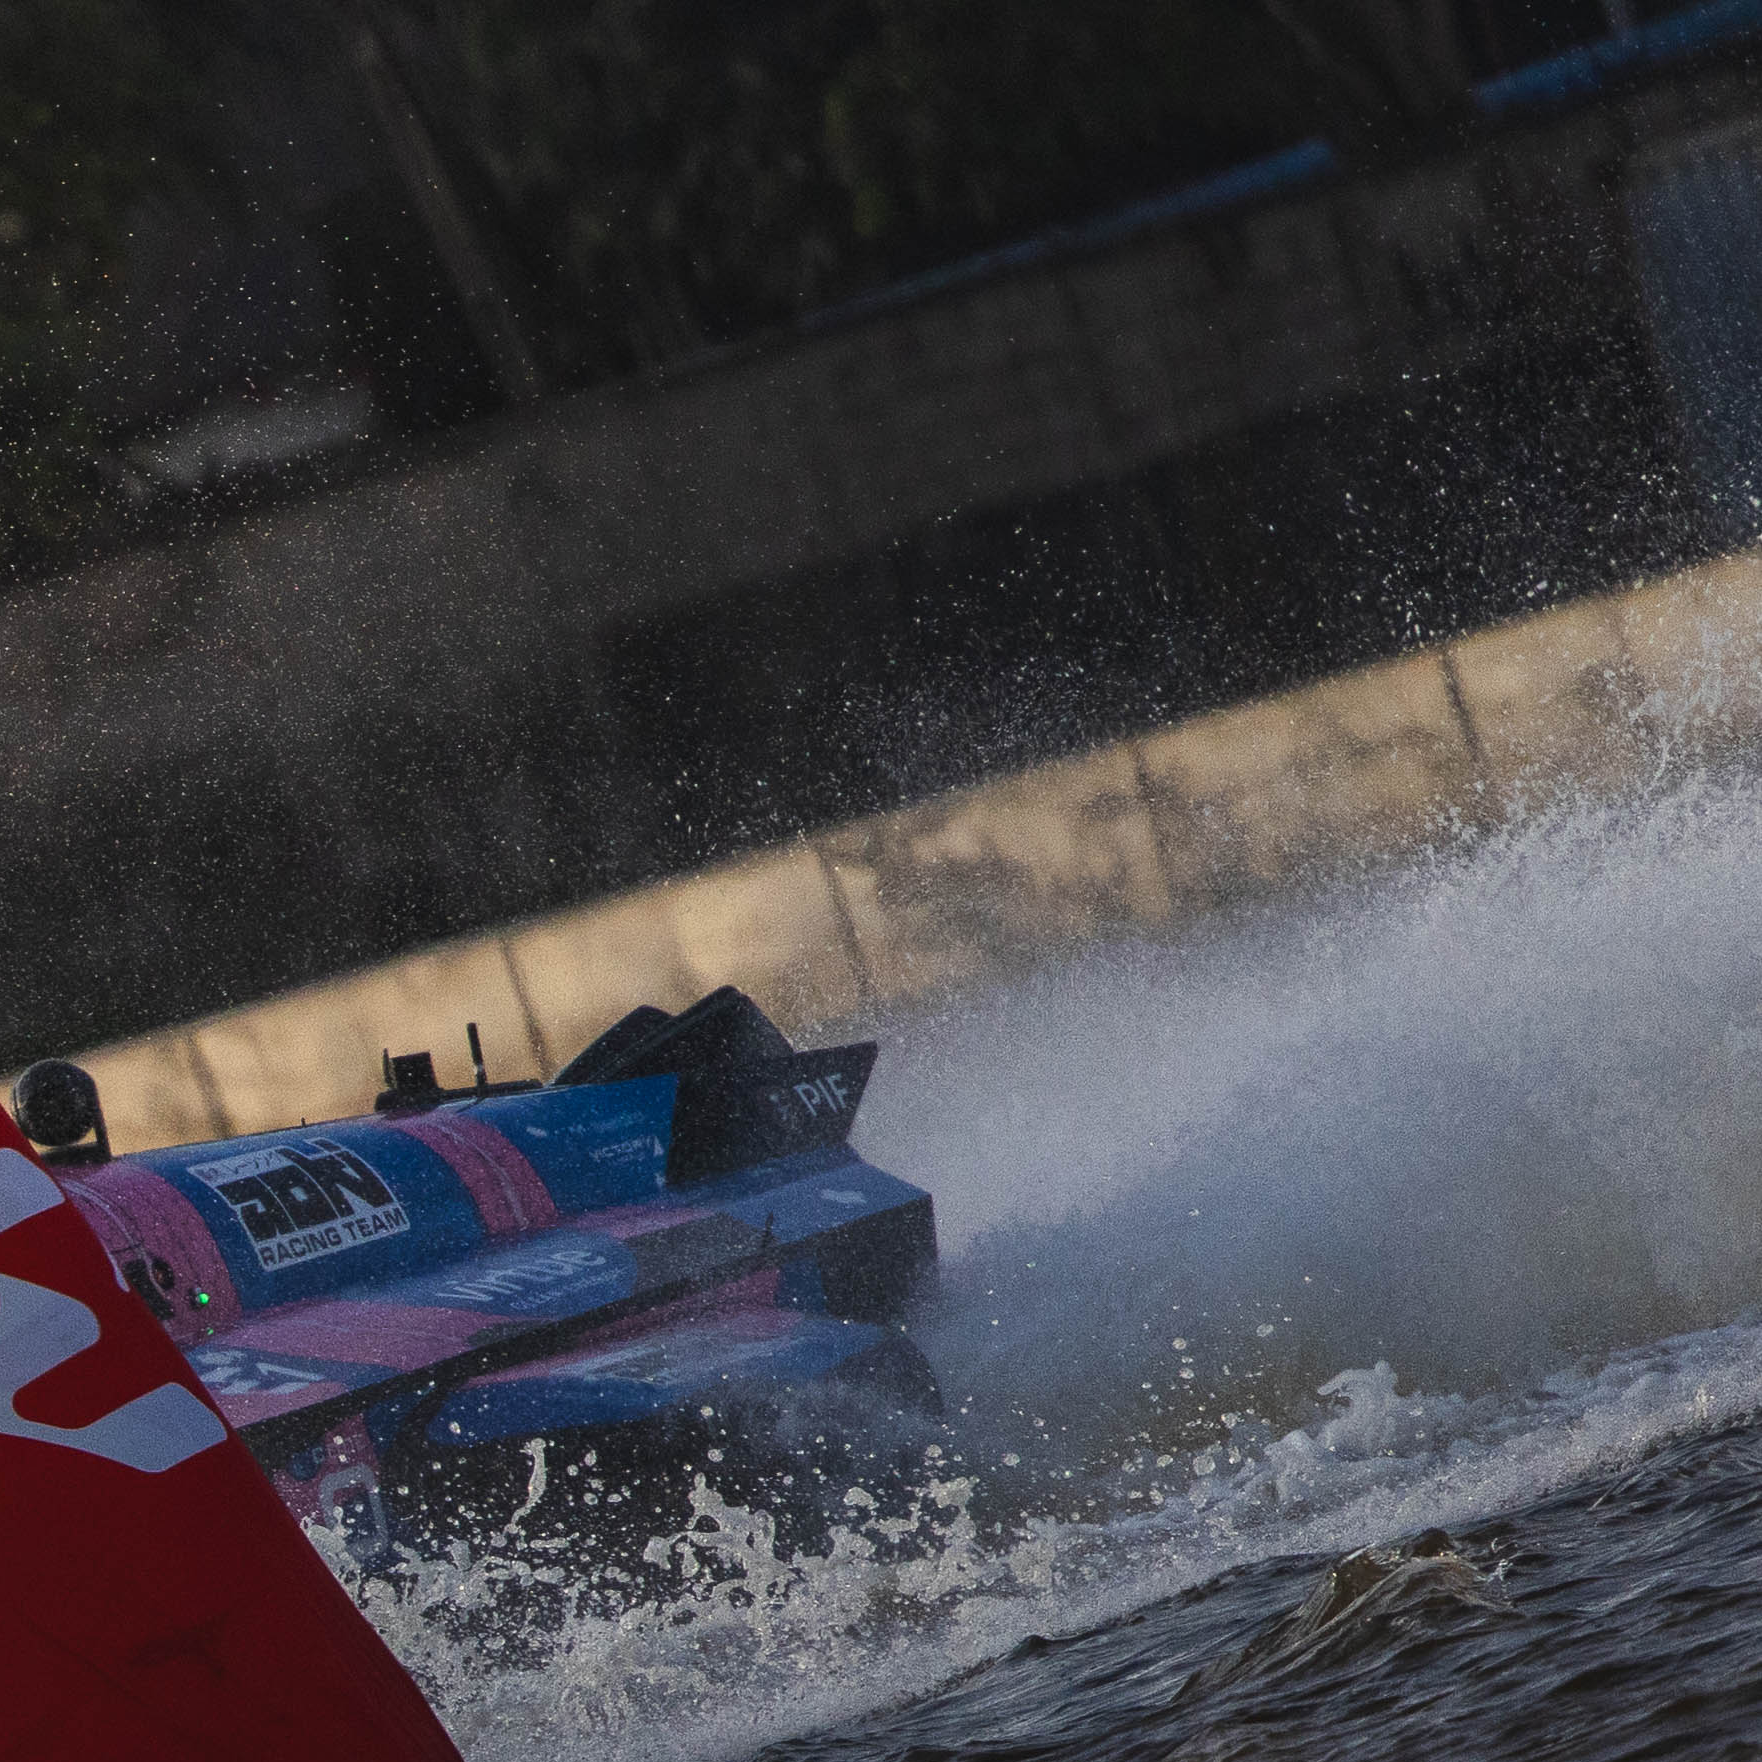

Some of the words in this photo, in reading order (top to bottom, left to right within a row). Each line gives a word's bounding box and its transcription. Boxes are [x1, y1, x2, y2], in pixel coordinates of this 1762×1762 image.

[793, 1073, 849, 1116] PIF
[257, 1225, 343, 1267] RACING
[342, 1206, 408, 1241] TEAM
